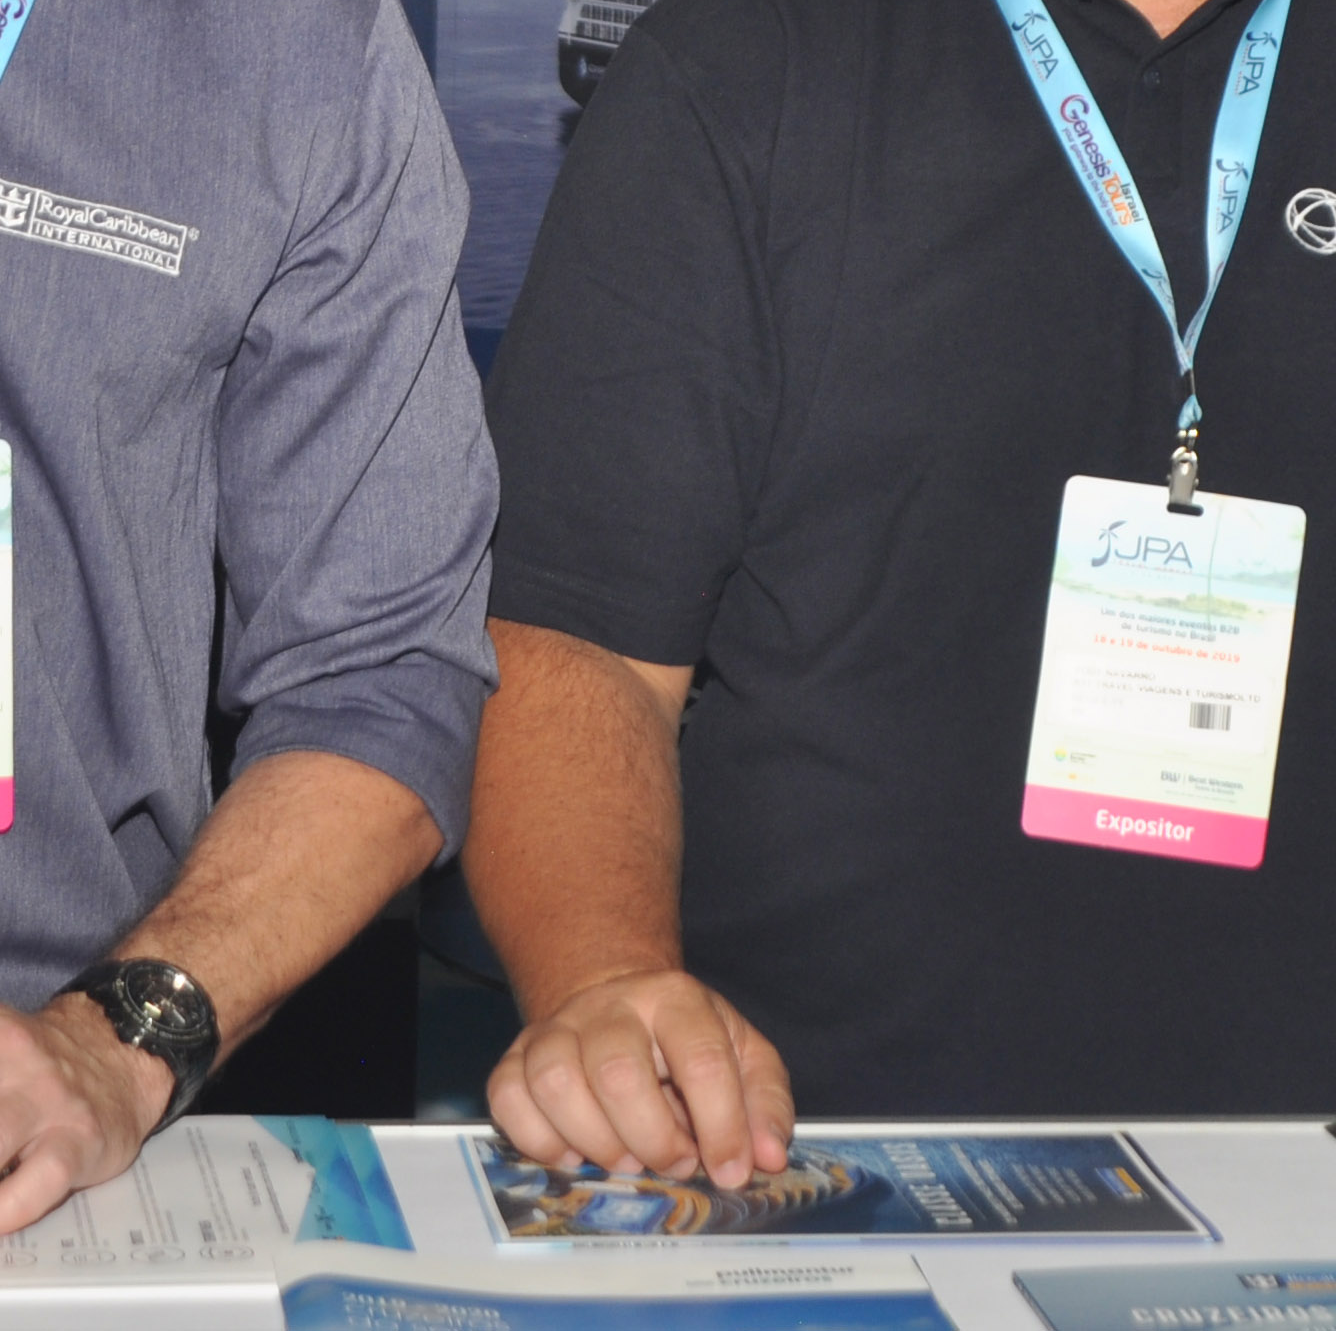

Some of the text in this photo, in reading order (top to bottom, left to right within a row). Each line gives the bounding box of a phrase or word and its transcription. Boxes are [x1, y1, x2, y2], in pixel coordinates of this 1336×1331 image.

[1024, 25, 1060, 80] JPA
[1238, 44, 1267, 96] JPA
[1060, 94, 1134, 227] Genesis Tours
[1120, 182, 1145, 223] Israel
[1217, 175, 1239, 235] JPA
[35, 222, 175, 270] INTERNATIONAL
[1114, 535, 1193, 569] JPA
[1095, 809, 1195, 842] Expositor
[1130, 1304, 1334, 1326] CRUZEIROS
